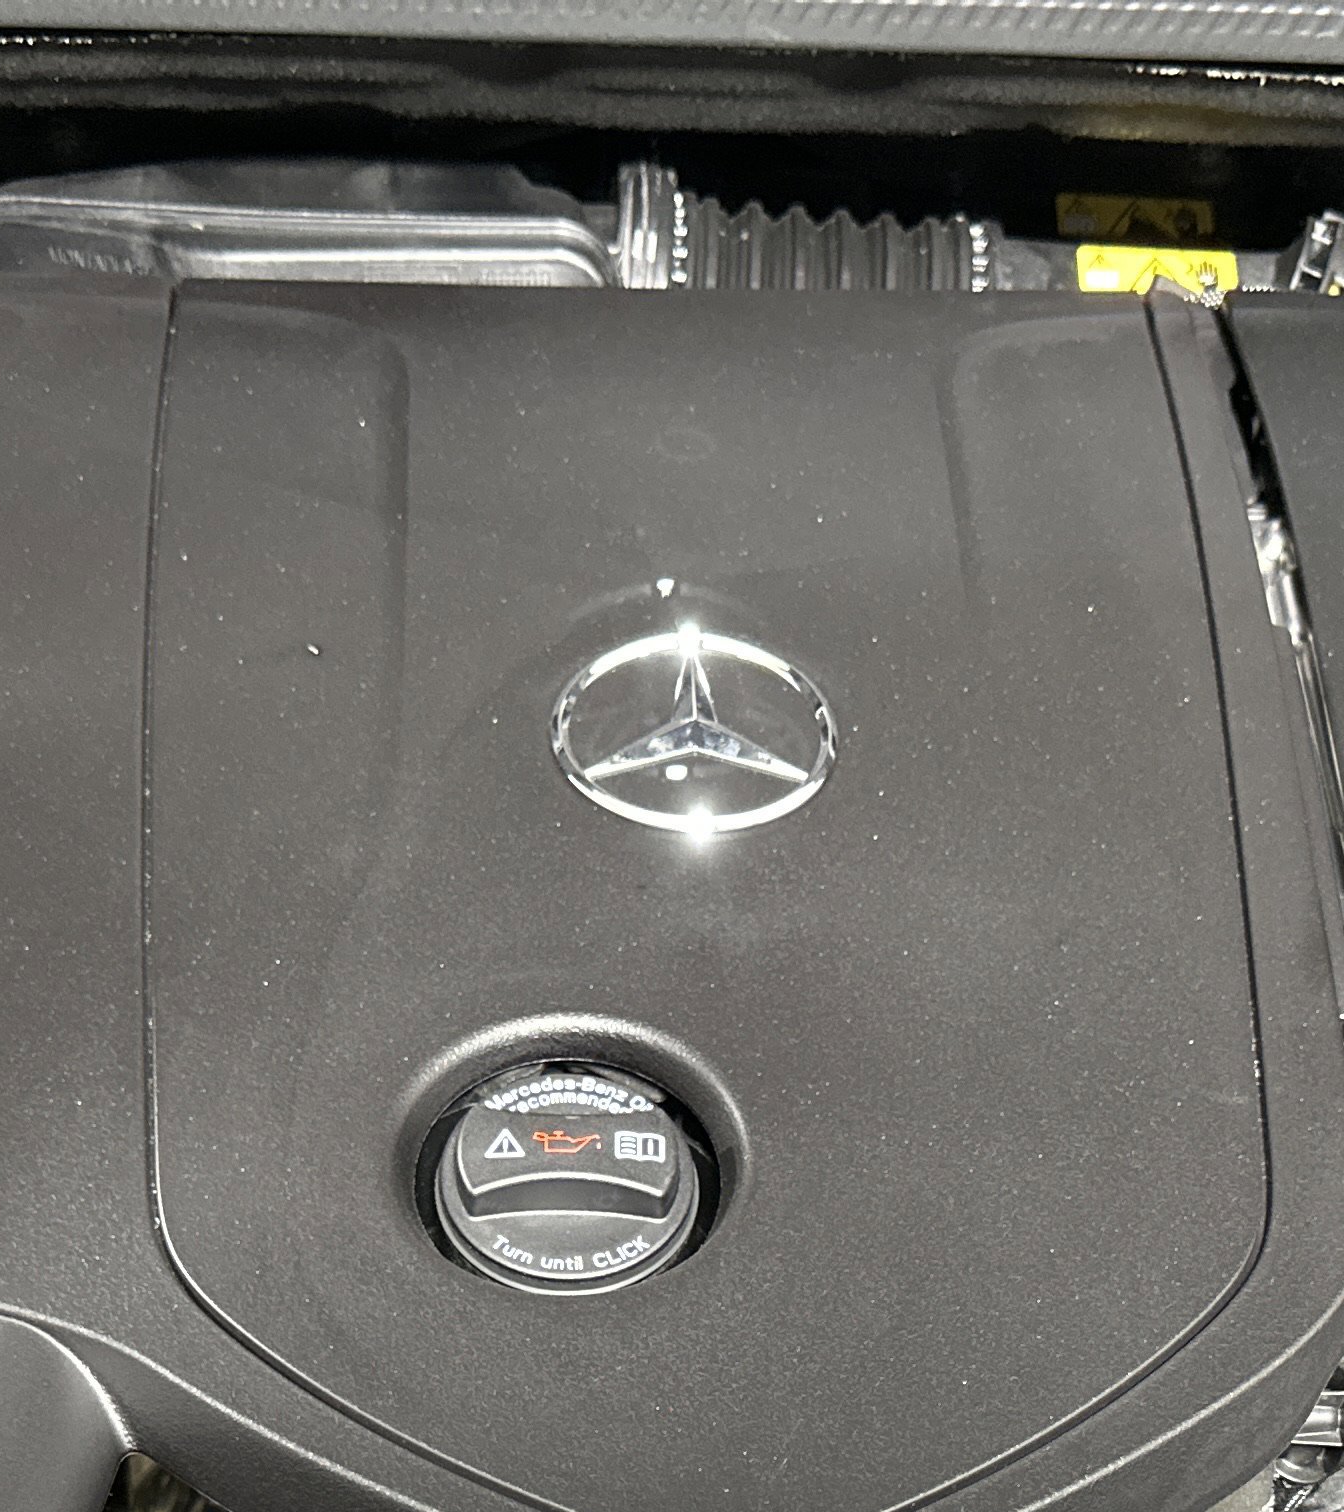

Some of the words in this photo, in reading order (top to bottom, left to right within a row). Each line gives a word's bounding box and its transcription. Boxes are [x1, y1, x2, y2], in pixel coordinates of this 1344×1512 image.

[484, 1077, 628, 1111] Mercedes-Benz
[493, 1234, 533, 1264] Turn
[540, 1255, 584, 1271] until
[592, 1234, 650, 1268] CLICK
